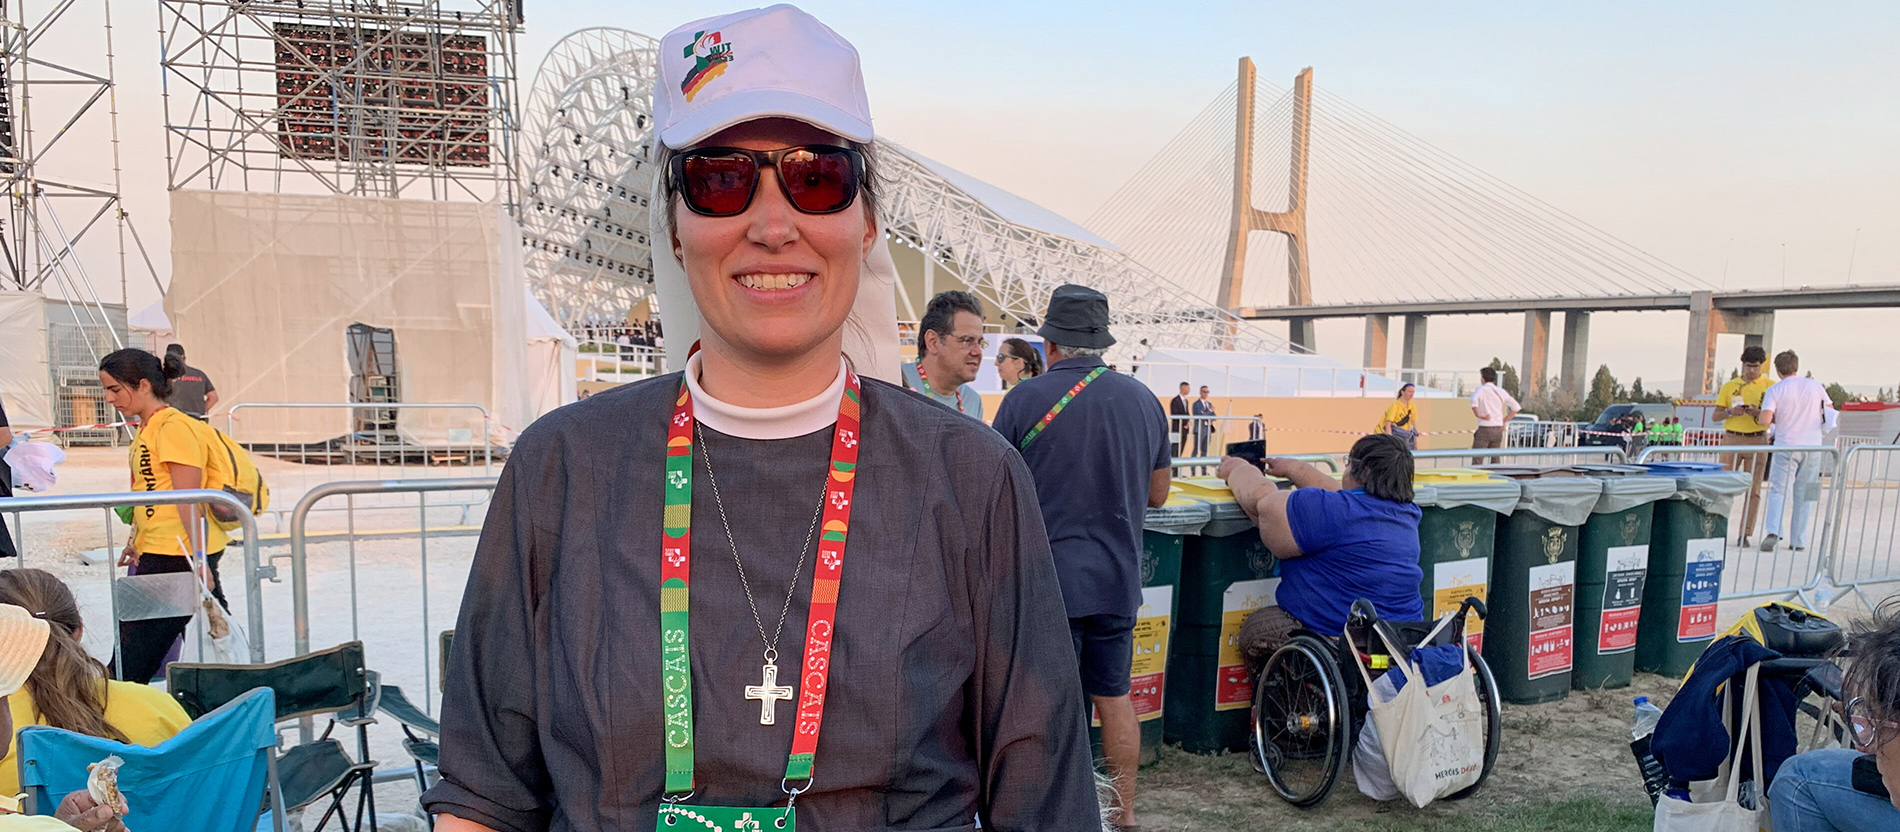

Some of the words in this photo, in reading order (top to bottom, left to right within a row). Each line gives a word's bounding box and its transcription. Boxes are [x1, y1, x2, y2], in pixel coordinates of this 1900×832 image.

[139, 444, 157, 521] ONTÁRIO
[664, 629, 689, 748] CASCAIS
[799, 619, 831, 735] CASCAIS
